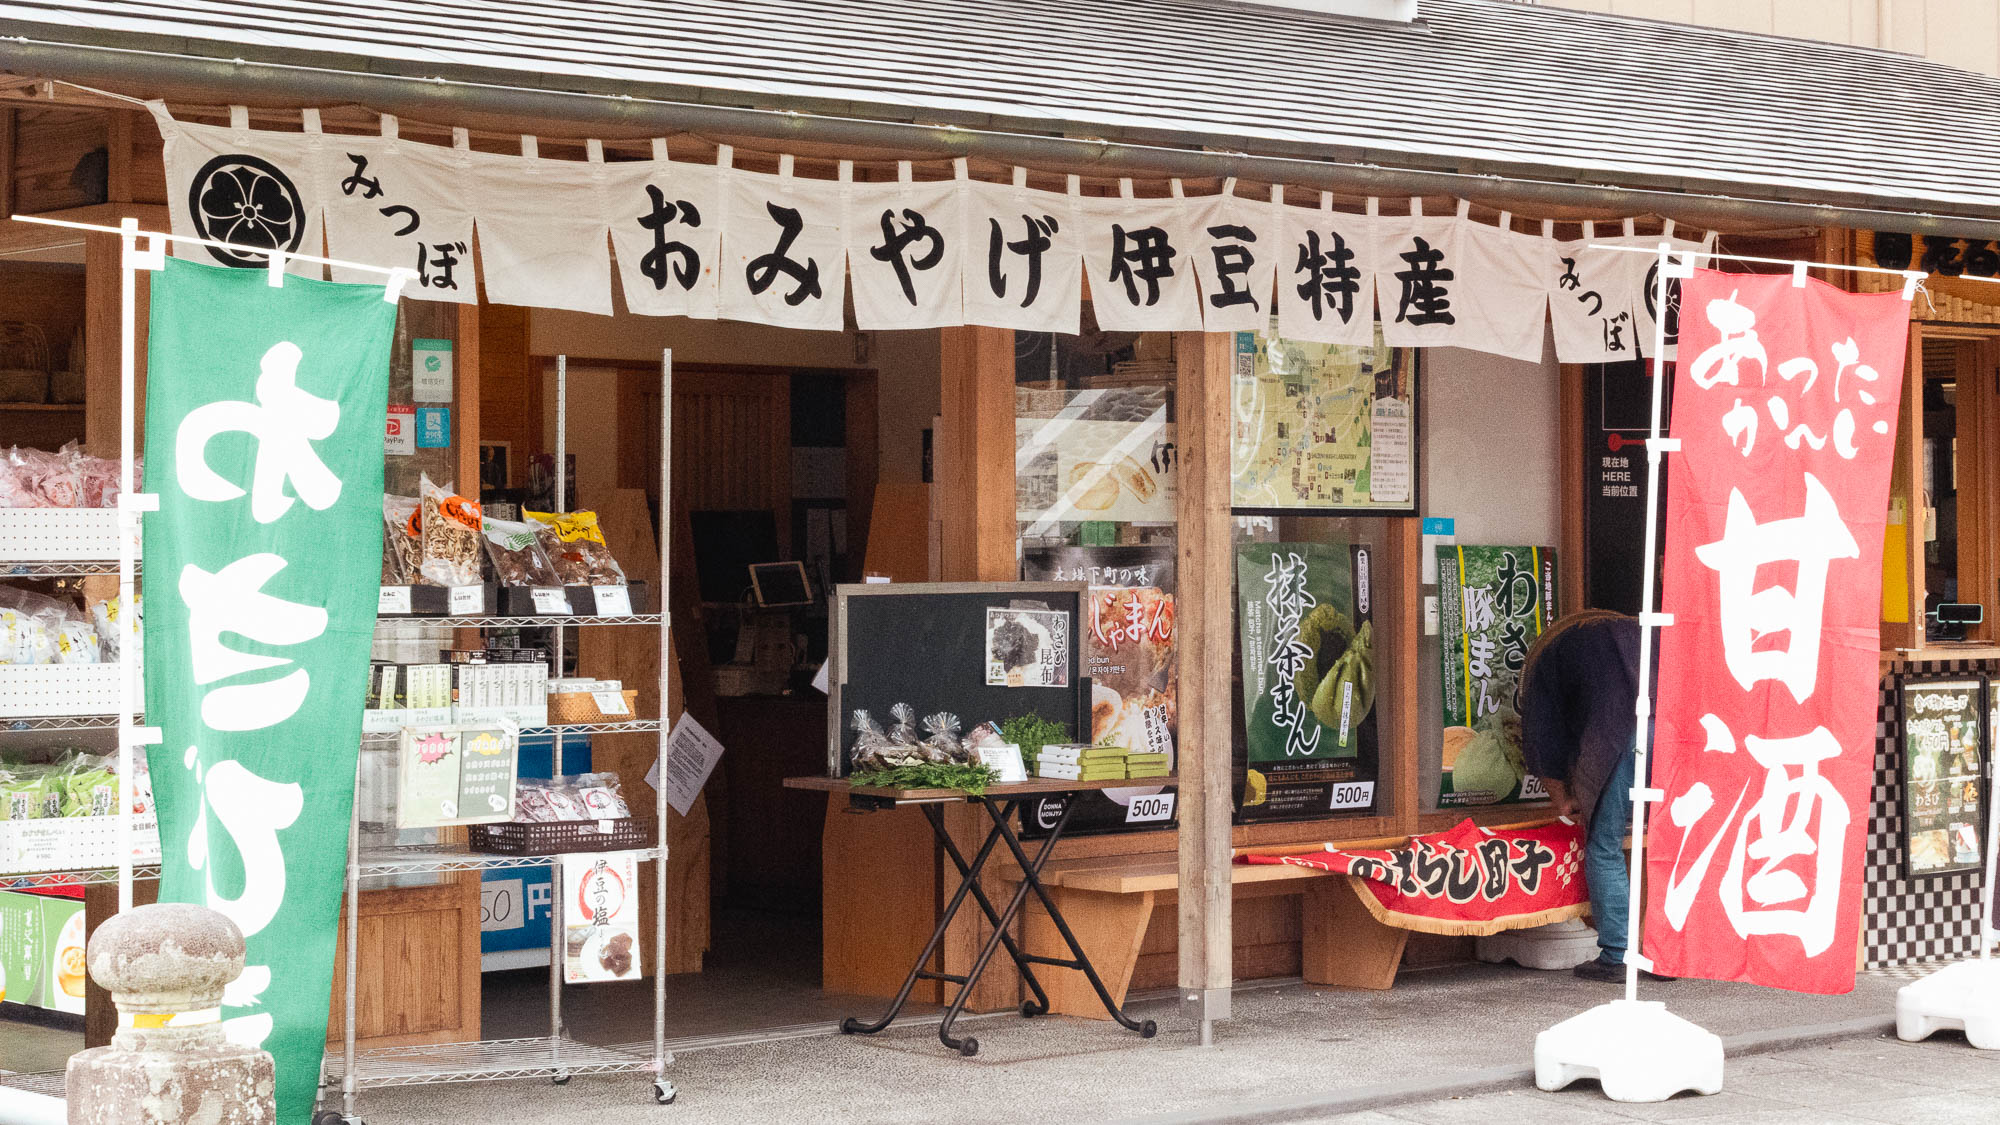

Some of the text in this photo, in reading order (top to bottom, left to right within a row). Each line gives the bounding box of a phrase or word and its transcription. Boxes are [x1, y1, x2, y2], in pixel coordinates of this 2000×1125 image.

[340, 152, 467, 290] みつぼ
[1559, 256, 1630, 354] みつぼ
[1602, 456, 1629, 468] 現在地
[1602, 471, 1631, 482] HERE
[1602, 485, 1638, 497] 当前位置
[1040, 648, 1053, 685] 昆布
[1053, 614, 1067, 666] わさび
[1254, 600, 1266, 695] Matcha steamed bun
[1264, 552, 1321, 757] 抹茶まん
[1462, 583, 1501, 718] 豚まん
[1664, 471, 1861, 959] 甘酒
[1132, 798, 1169, 818] 500円
[1336, 786, 1370, 805] 500円
[592, 858, 611, 927] 伊豆の塩
